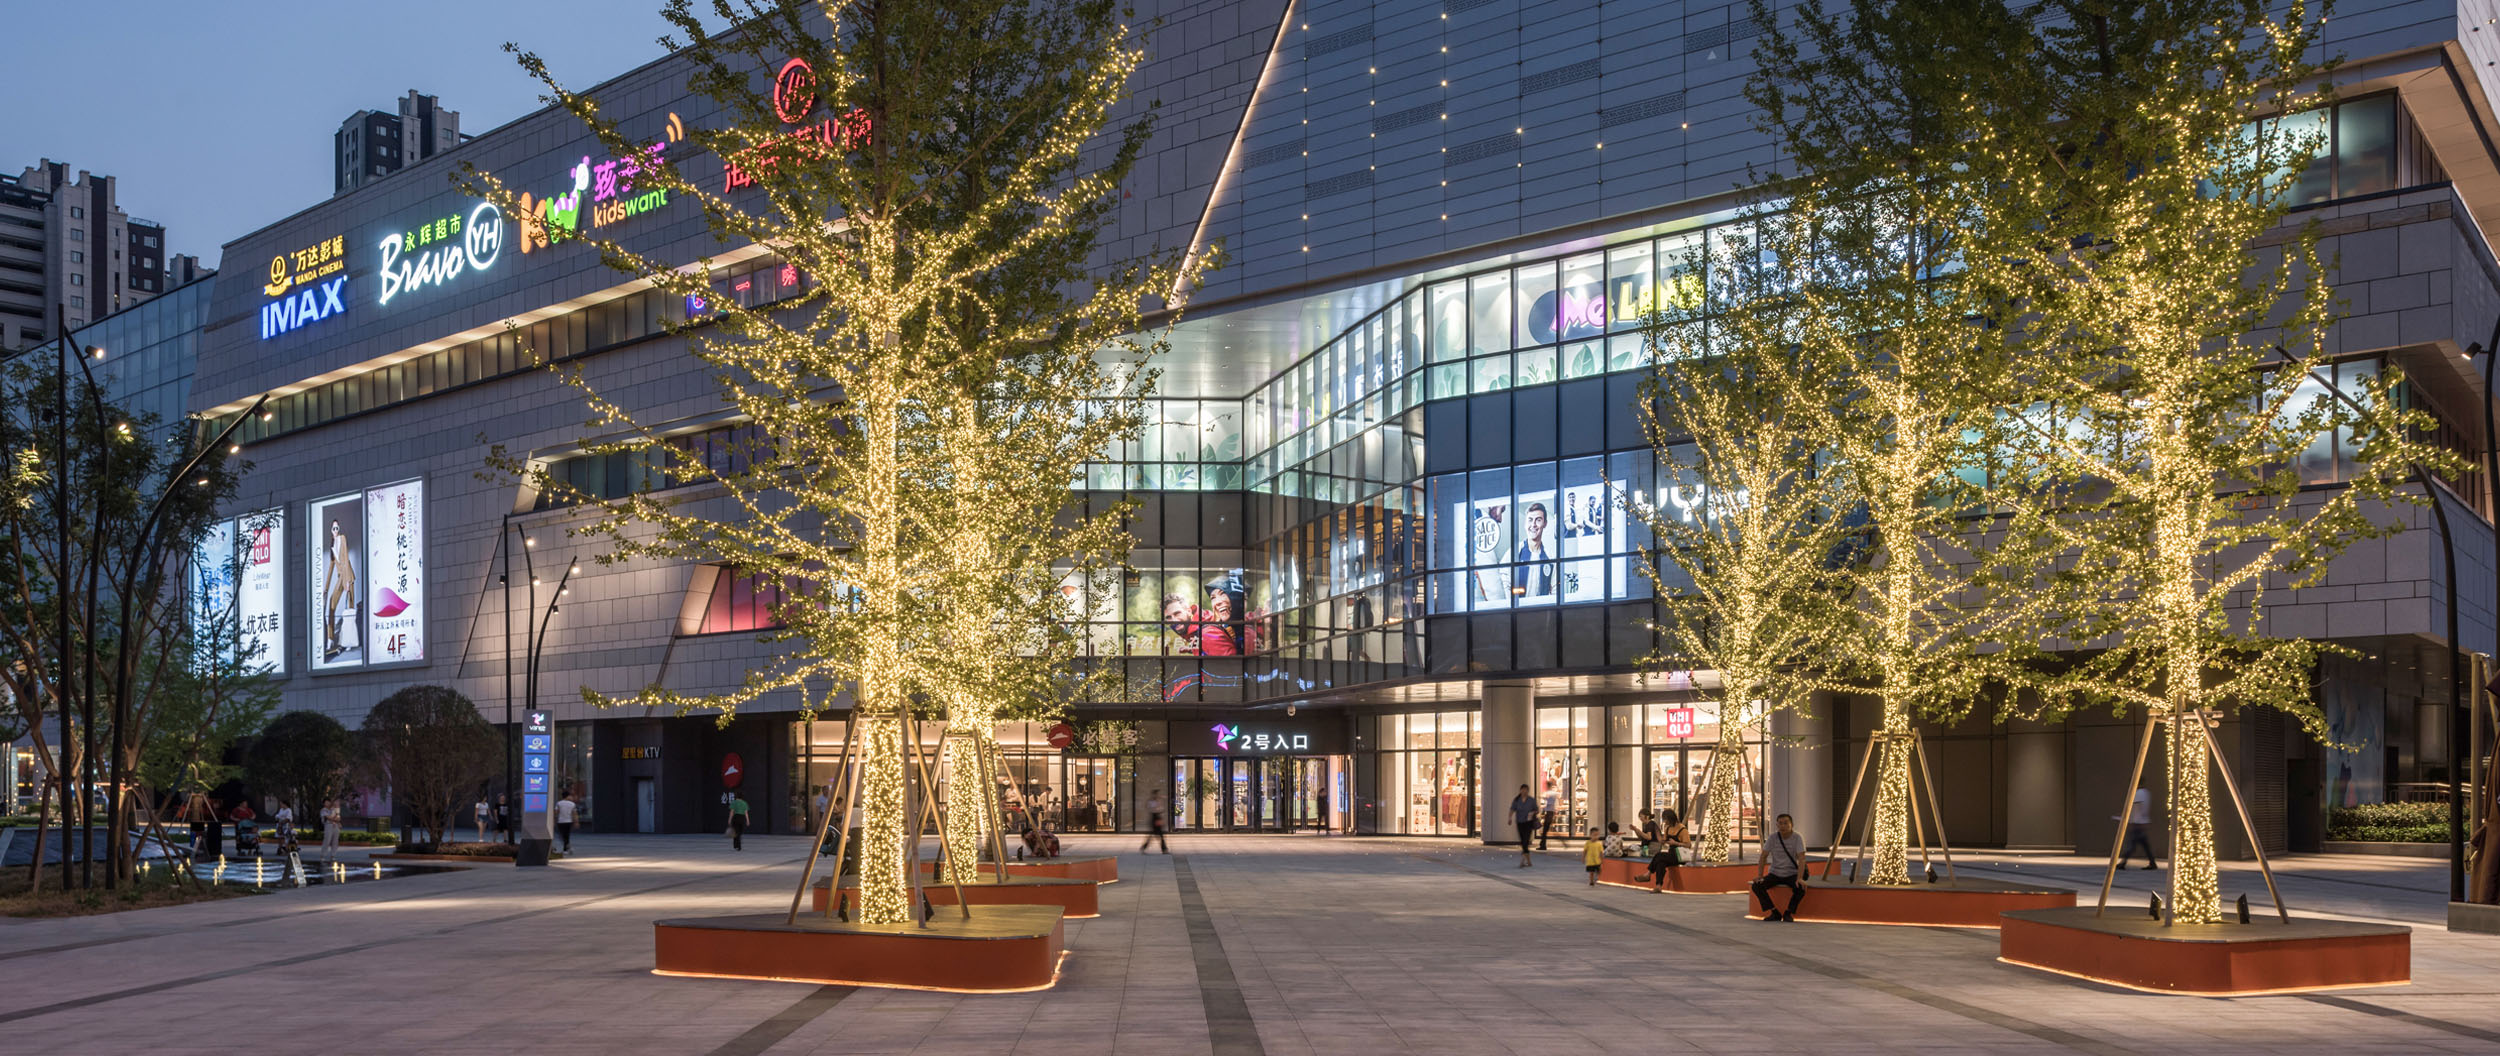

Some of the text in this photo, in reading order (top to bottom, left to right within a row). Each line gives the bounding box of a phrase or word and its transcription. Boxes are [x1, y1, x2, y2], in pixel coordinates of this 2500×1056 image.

[594, 187, 668, 228] kidswant
[404, 213, 461, 252] 永辉超市
[472, 218, 499, 255] YH
[296, 235, 344, 272] 万达影城
[379, 233, 465, 305] Bravo
[295, 260, 344, 286] WANDA CINEMA
[262, 277, 345, 340] IMAX
[255, 547, 269, 562] QLO
[396, 493, 408, 593] 暗恋桃花源
[247, 612, 279, 635] 优衣库
[387, 634, 406, 655] 4F
[1669, 711, 1689, 723] UNI
[1669, 723, 1691, 737] QLO
[1240, 734, 1308, 750] 2号入口
